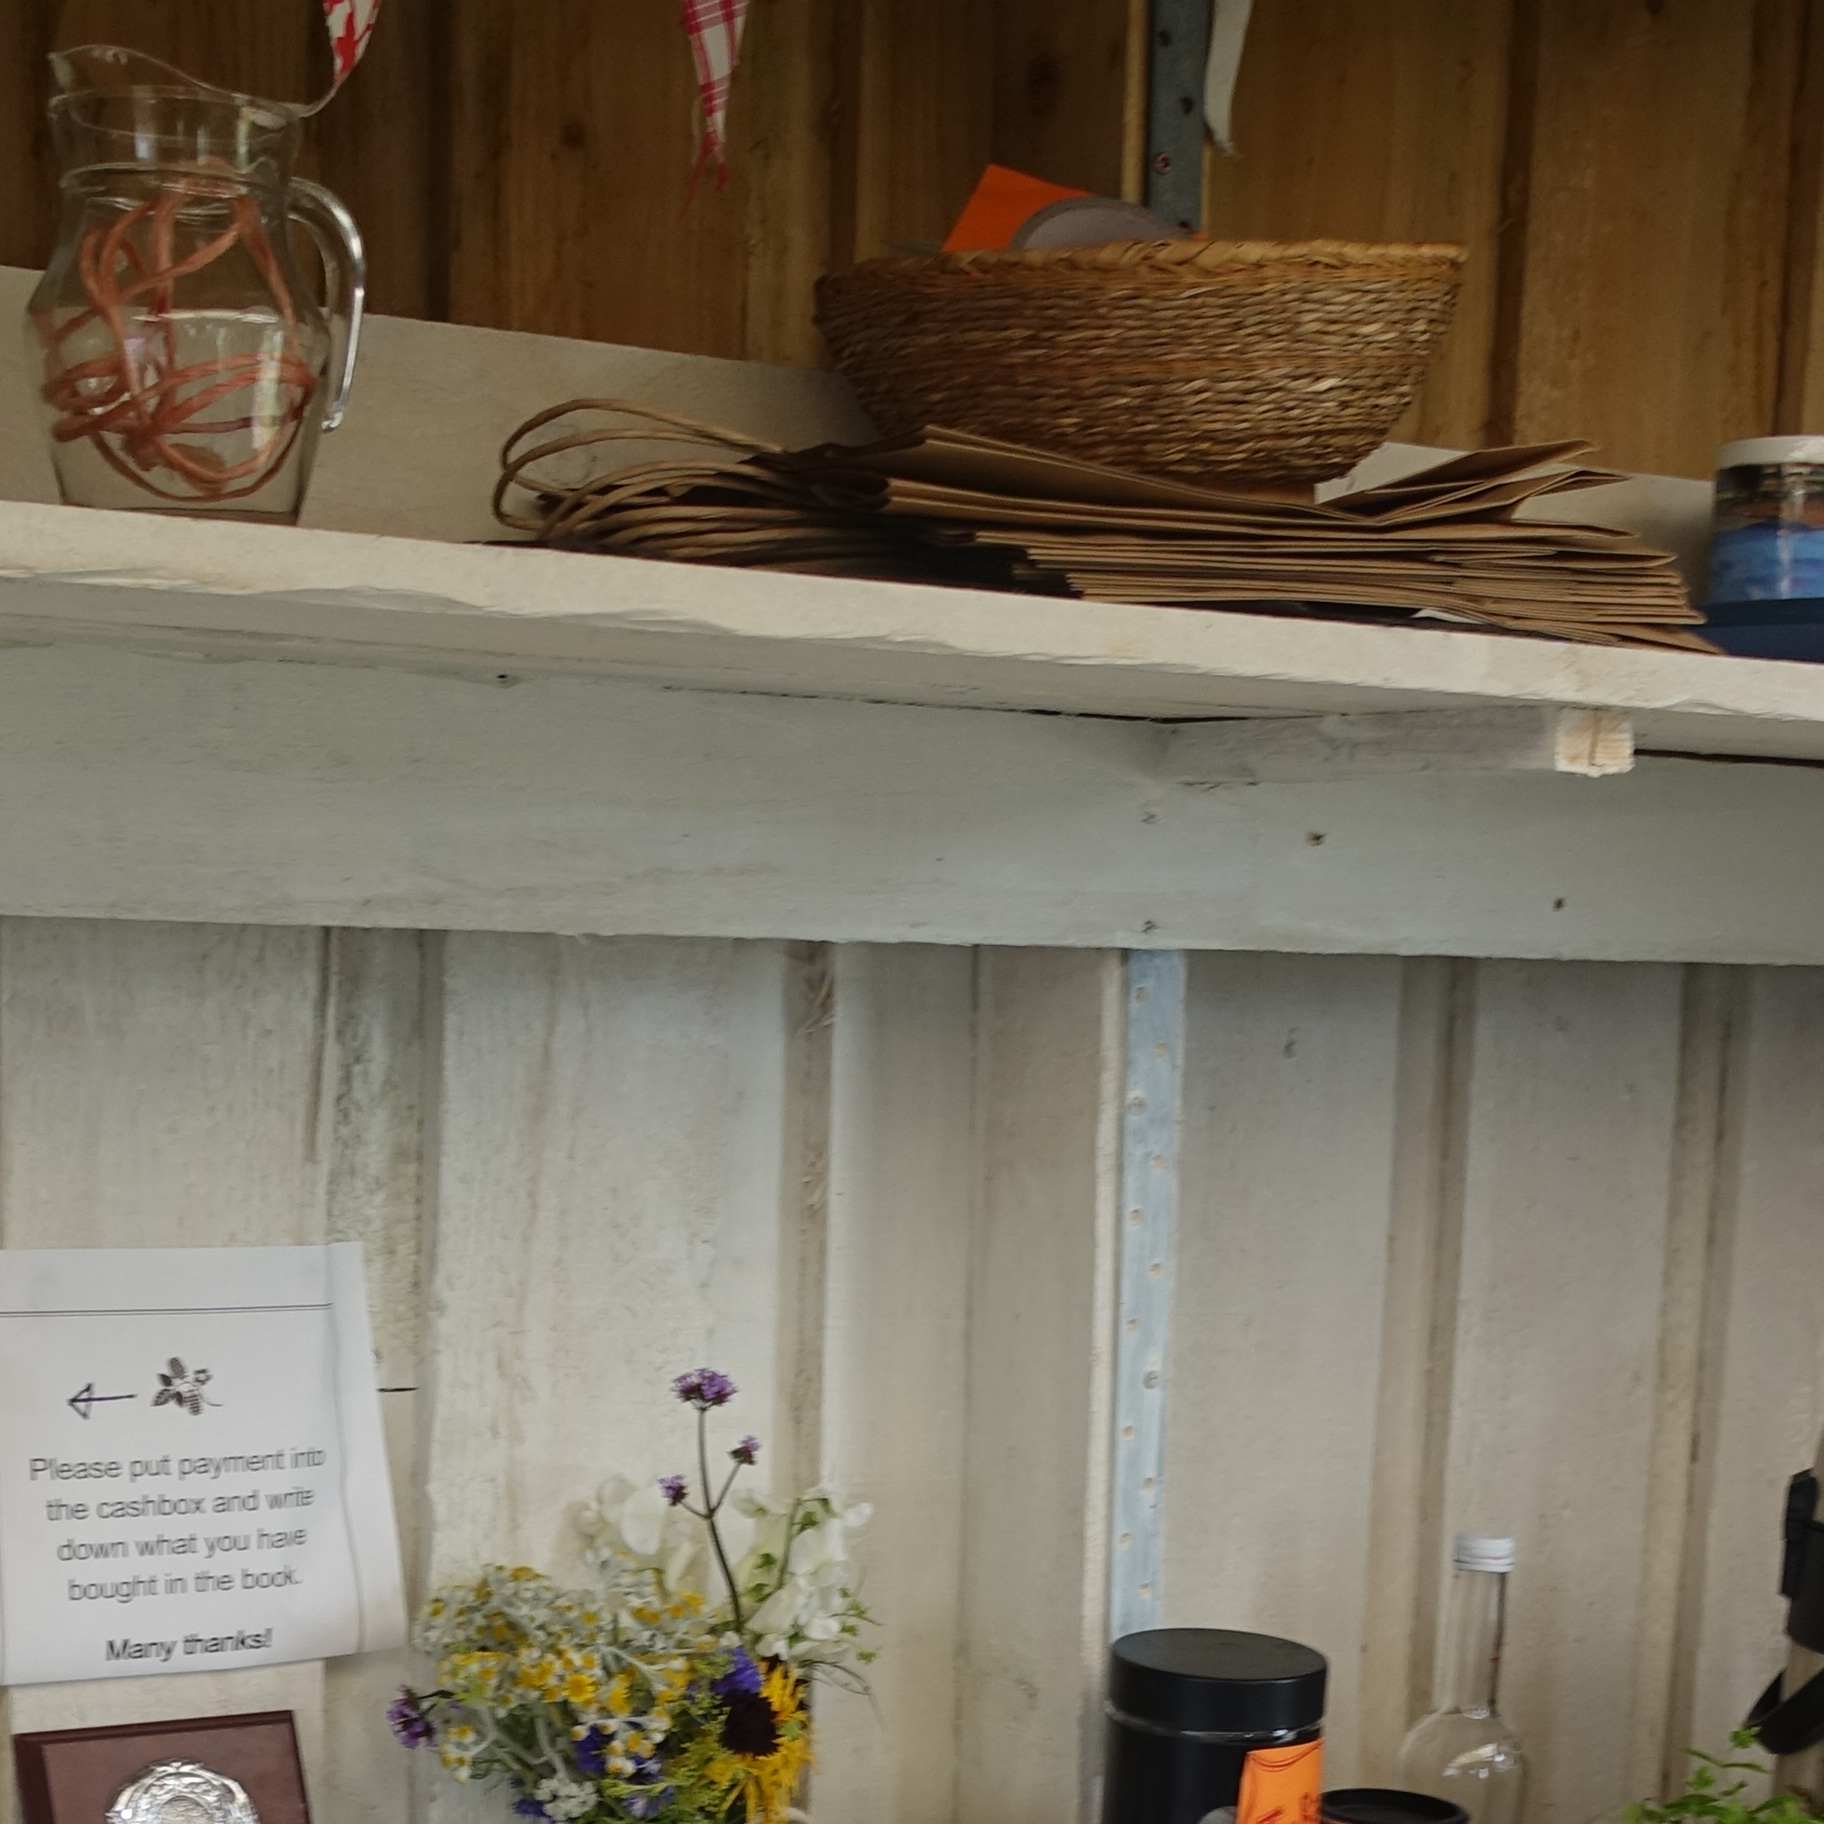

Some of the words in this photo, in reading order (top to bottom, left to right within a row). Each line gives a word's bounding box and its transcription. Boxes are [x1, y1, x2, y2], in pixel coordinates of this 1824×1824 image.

[28, 1455, 123, 1481] Please
[128, 1452, 173, 1482] put
[177, 1448, 286, 1481] payment
[289, 1446, 327, 1468] into
[45, 1497, 90, 1521] the
[95, 1492, 206, 1519] cashbox
[212, 1489, 259, 1513] and
[264, 1486, 316, 1509] write
[56, 1537, 129, 1563] down
[134, 1532, 198, 1557] what
[203, 1532, 251, 1559] you
[255, 1527, 308, 1549] have
[67, 1573, 159, 1604] bought
[163, 1572, 188, 1595] in
[193, 1568, 236, 1593] the
[240, 1564, 305, 1590] book.
[105, 1636, 176, 1664] Many
[181, 1626, 274, 1654] thanks!
